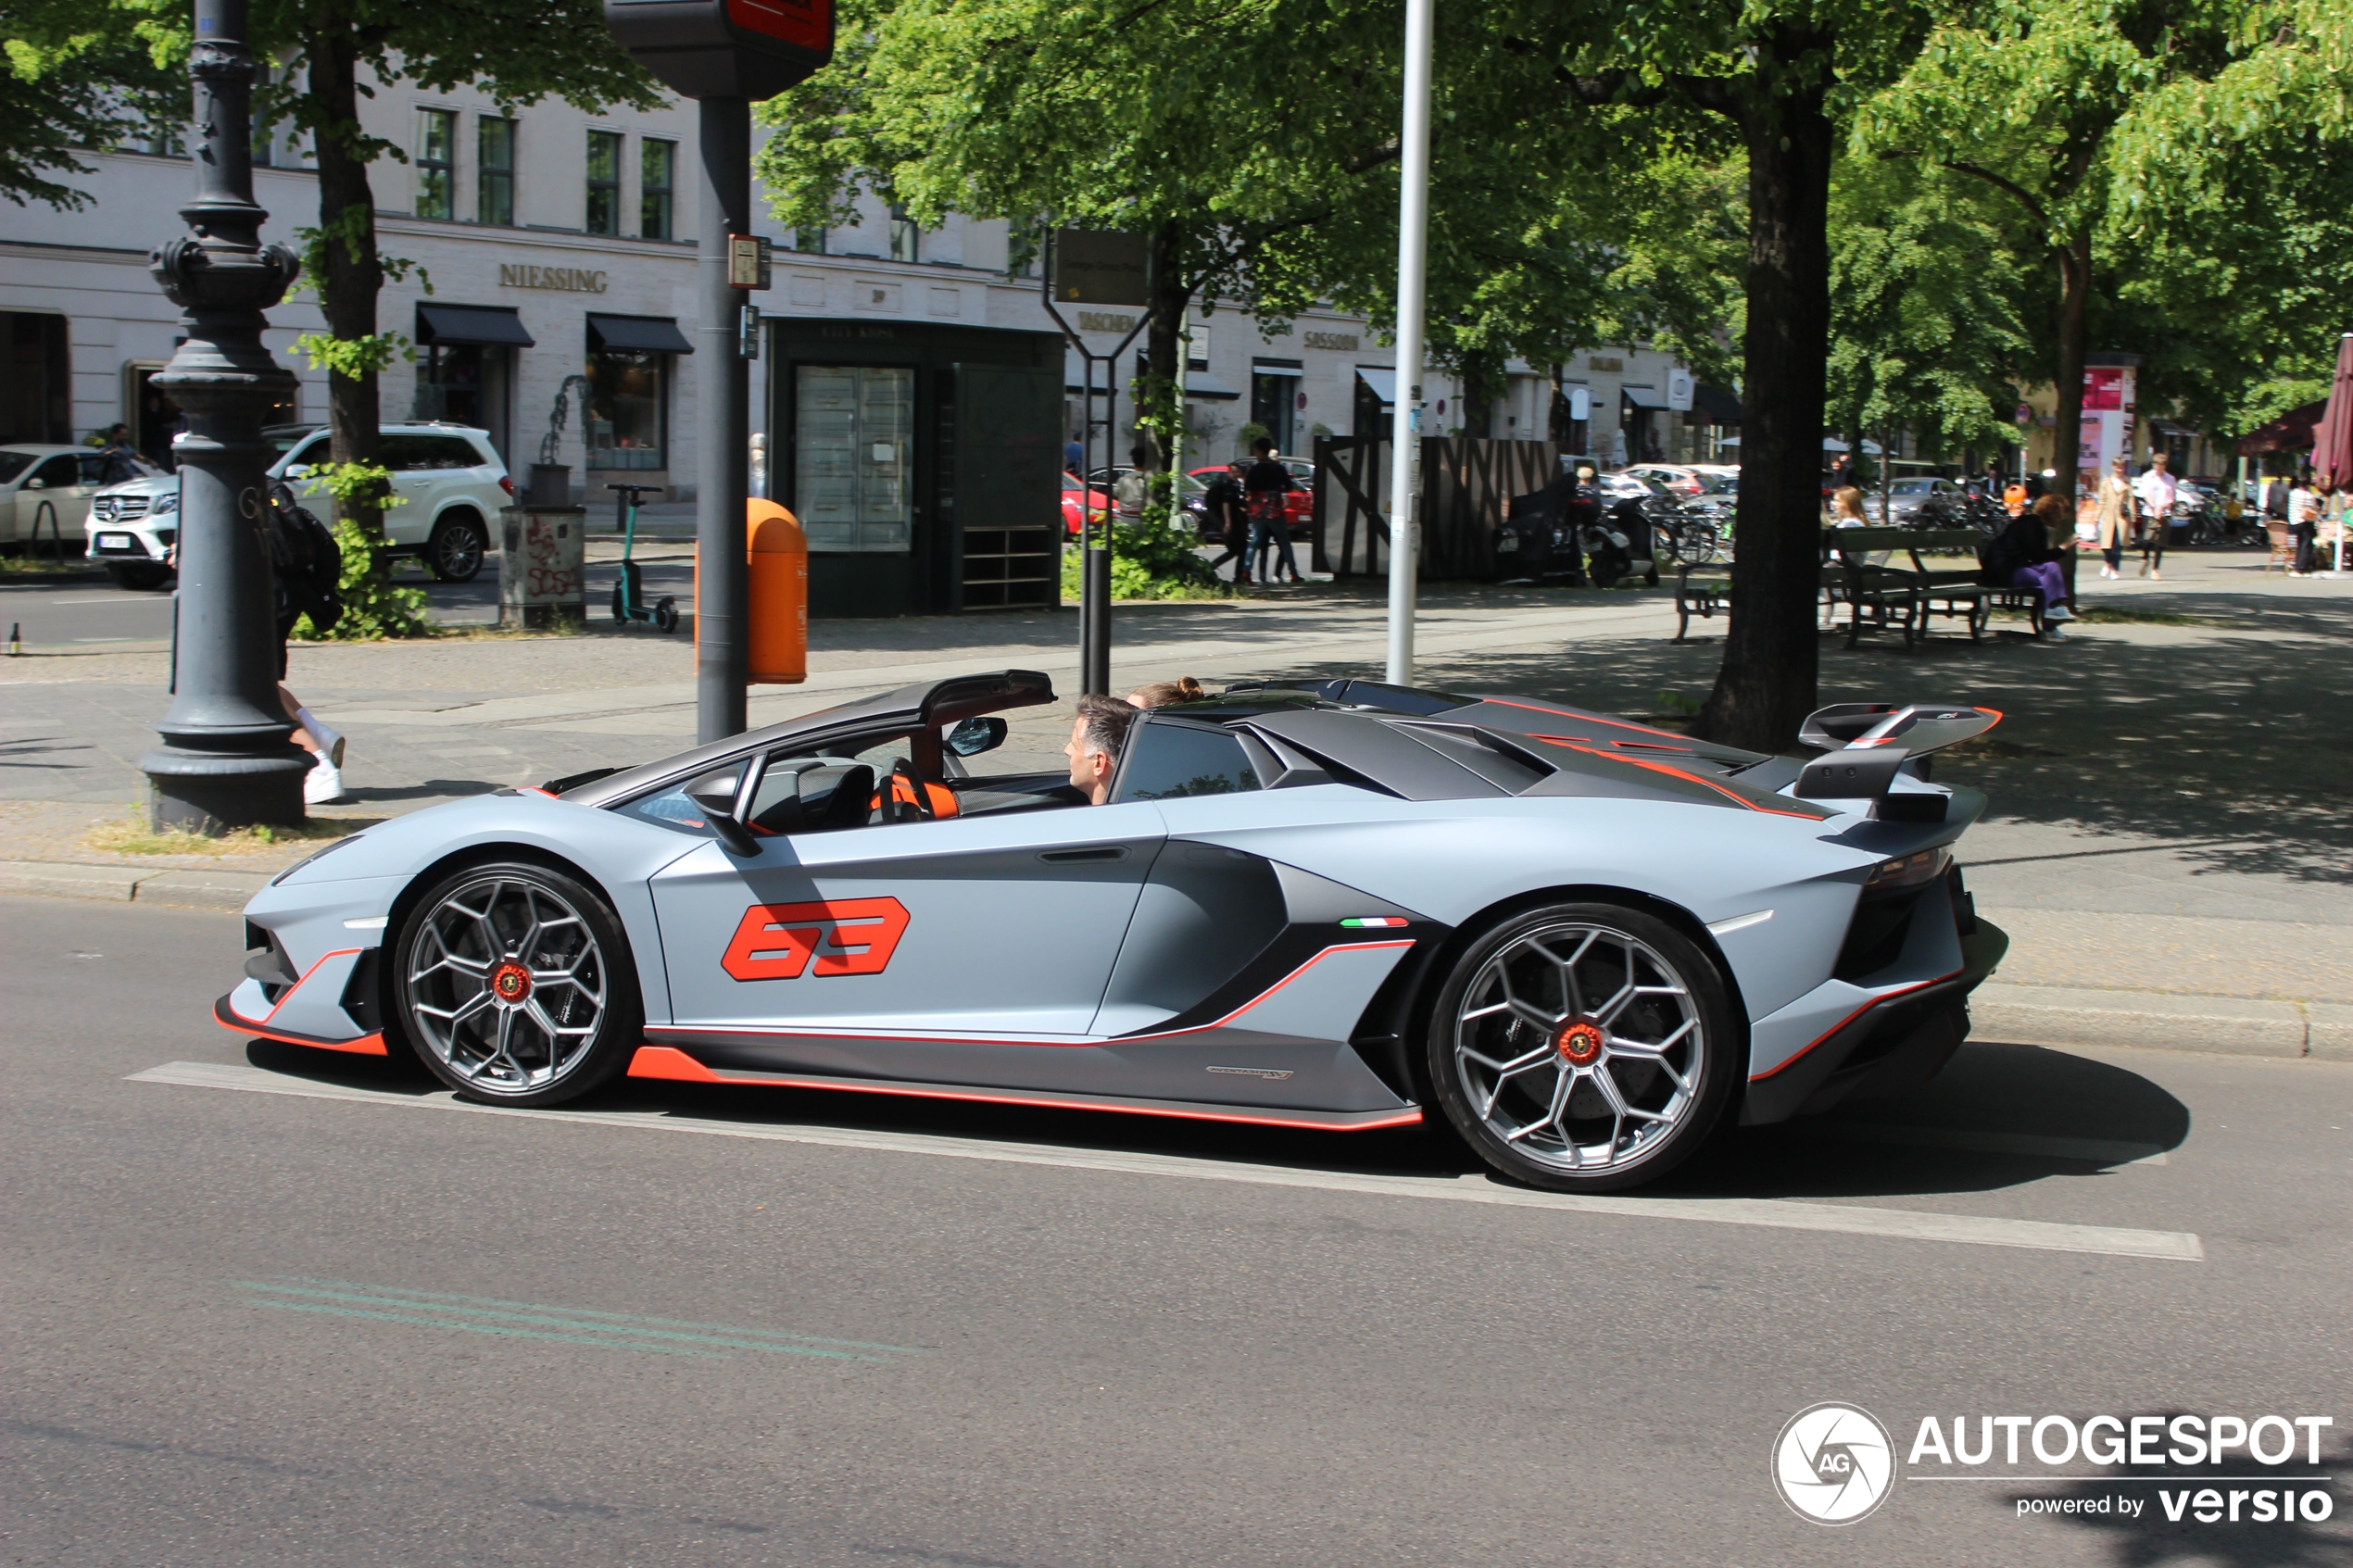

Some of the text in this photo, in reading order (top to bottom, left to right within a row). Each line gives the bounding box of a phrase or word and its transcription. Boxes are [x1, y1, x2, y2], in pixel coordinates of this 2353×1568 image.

[498, 263, 608, 293] NIESSING
[721, 896, 911, 983] 63
[1210, 1067, 1270, 1075] AVENTADOR
